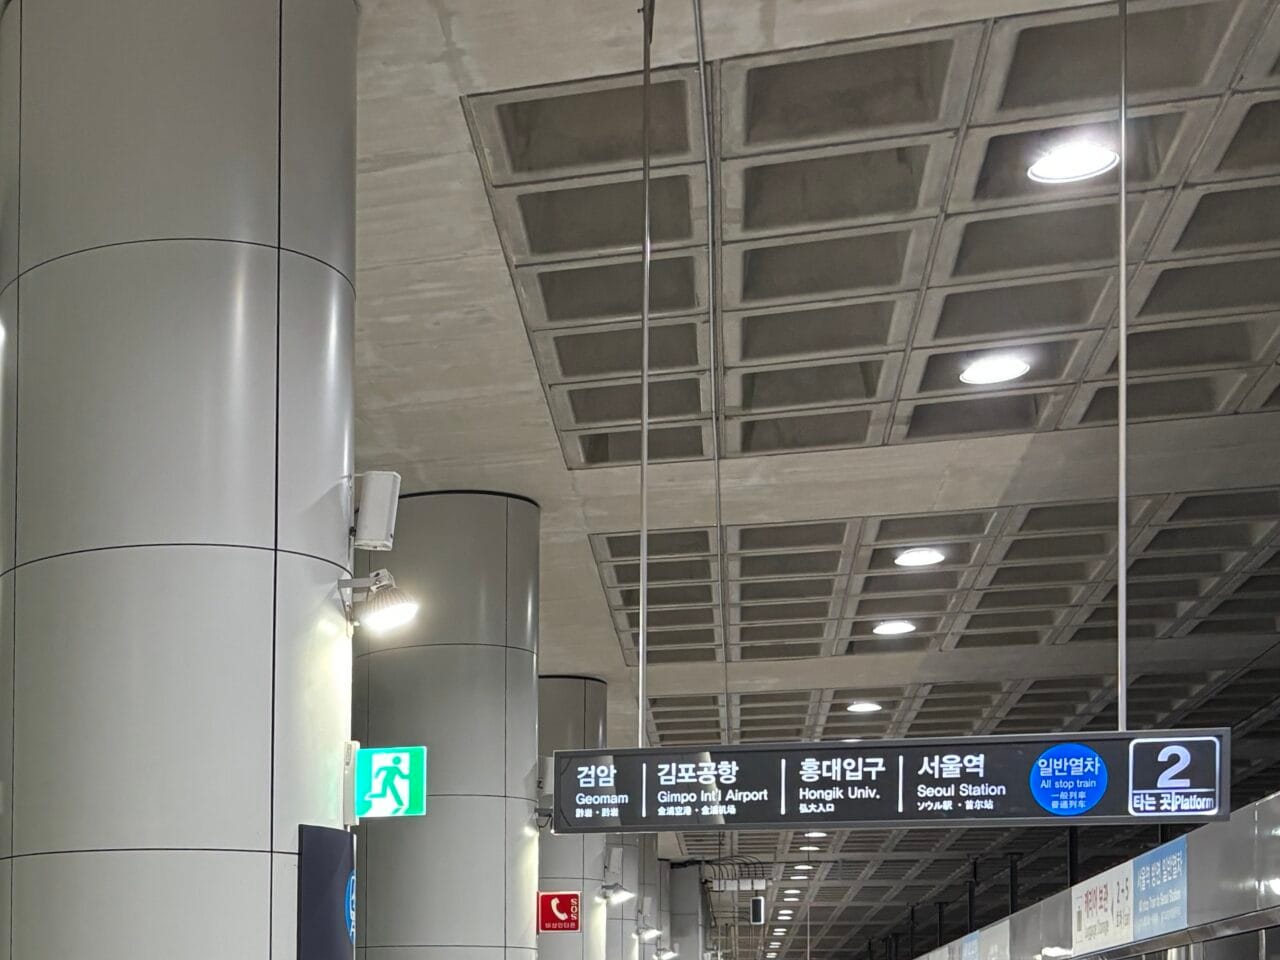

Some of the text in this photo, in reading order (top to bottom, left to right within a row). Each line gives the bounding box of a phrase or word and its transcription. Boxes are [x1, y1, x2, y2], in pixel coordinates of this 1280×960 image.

[657, 761, 739, 784] 김포공항
[799, 757, 886, 782] 홍대입구
[918, 754, 985, 778] 서울역
[1038, 756, 1101, 777] 일반열차
[1157, 745, 1191, 788] 2
[577, 765, 616, 787] 검암
[1040, 778, 1097, 790] All stop train
[575, 792, 629, 805] Geomam
[657, 787, 768, 804] Gimpo Int'l Airport
[799, 786, 881, 801] Hongik Univ.
[917, 782, 1006, 797] Seoul Station
[799, 803, 835, 813] 弘大入口
[1133, 793, 1171, 811] 타는 곳
[1174, 793, 1215, 810] Platform
[570, 898, 578, 920] SOS
